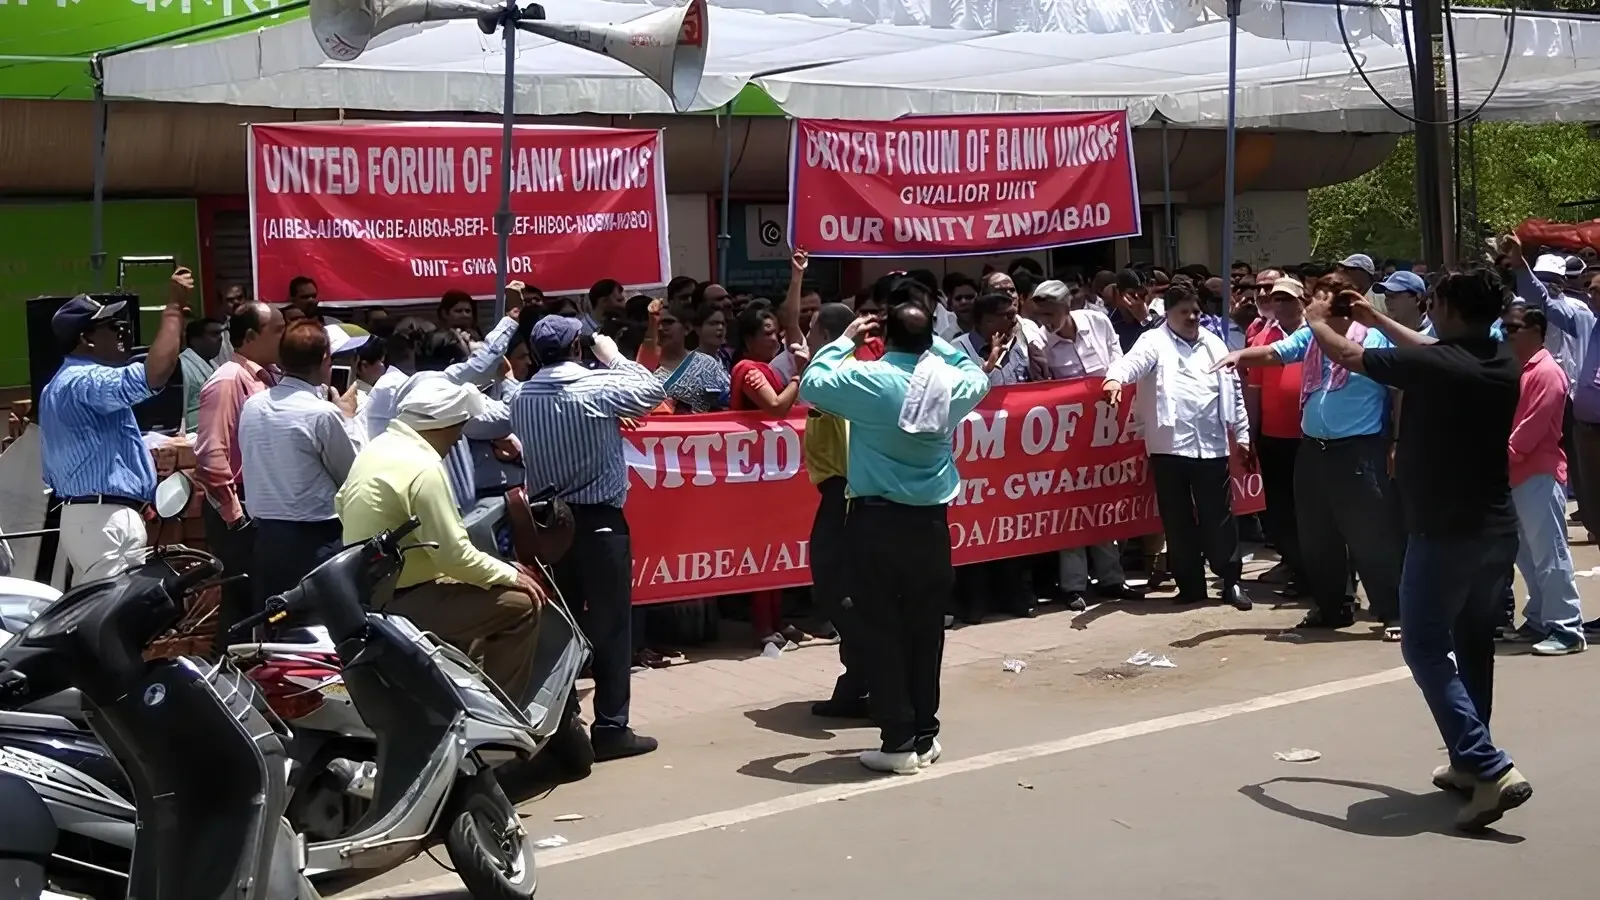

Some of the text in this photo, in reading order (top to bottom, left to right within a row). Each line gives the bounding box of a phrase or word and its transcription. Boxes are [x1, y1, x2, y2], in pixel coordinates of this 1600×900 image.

[262, 143, 359, 195] UNITED
[368, 144, 454, 195] FORUM
[462, 146, 493, 194] OF
[571, 145, 652, 192] UNIONS
[806, 120, 1120, 176] UNITED FORUM OF BANK UNIONS
[900, 180, 1038, 205] GWALIOR UNIT
[819, 202, 1111, 243] OUR UNITY ZINDABAD
[410, 258, 448, 277] UNIT
[462, 256, 533, 276] GWAIOR
[1021, 402, 1083, 455] OF
[1090, 394, 1146, 448] BA
[622, 424, 801, 490] NITED
[631, 540, 810, 588] /AIBEA/AI
